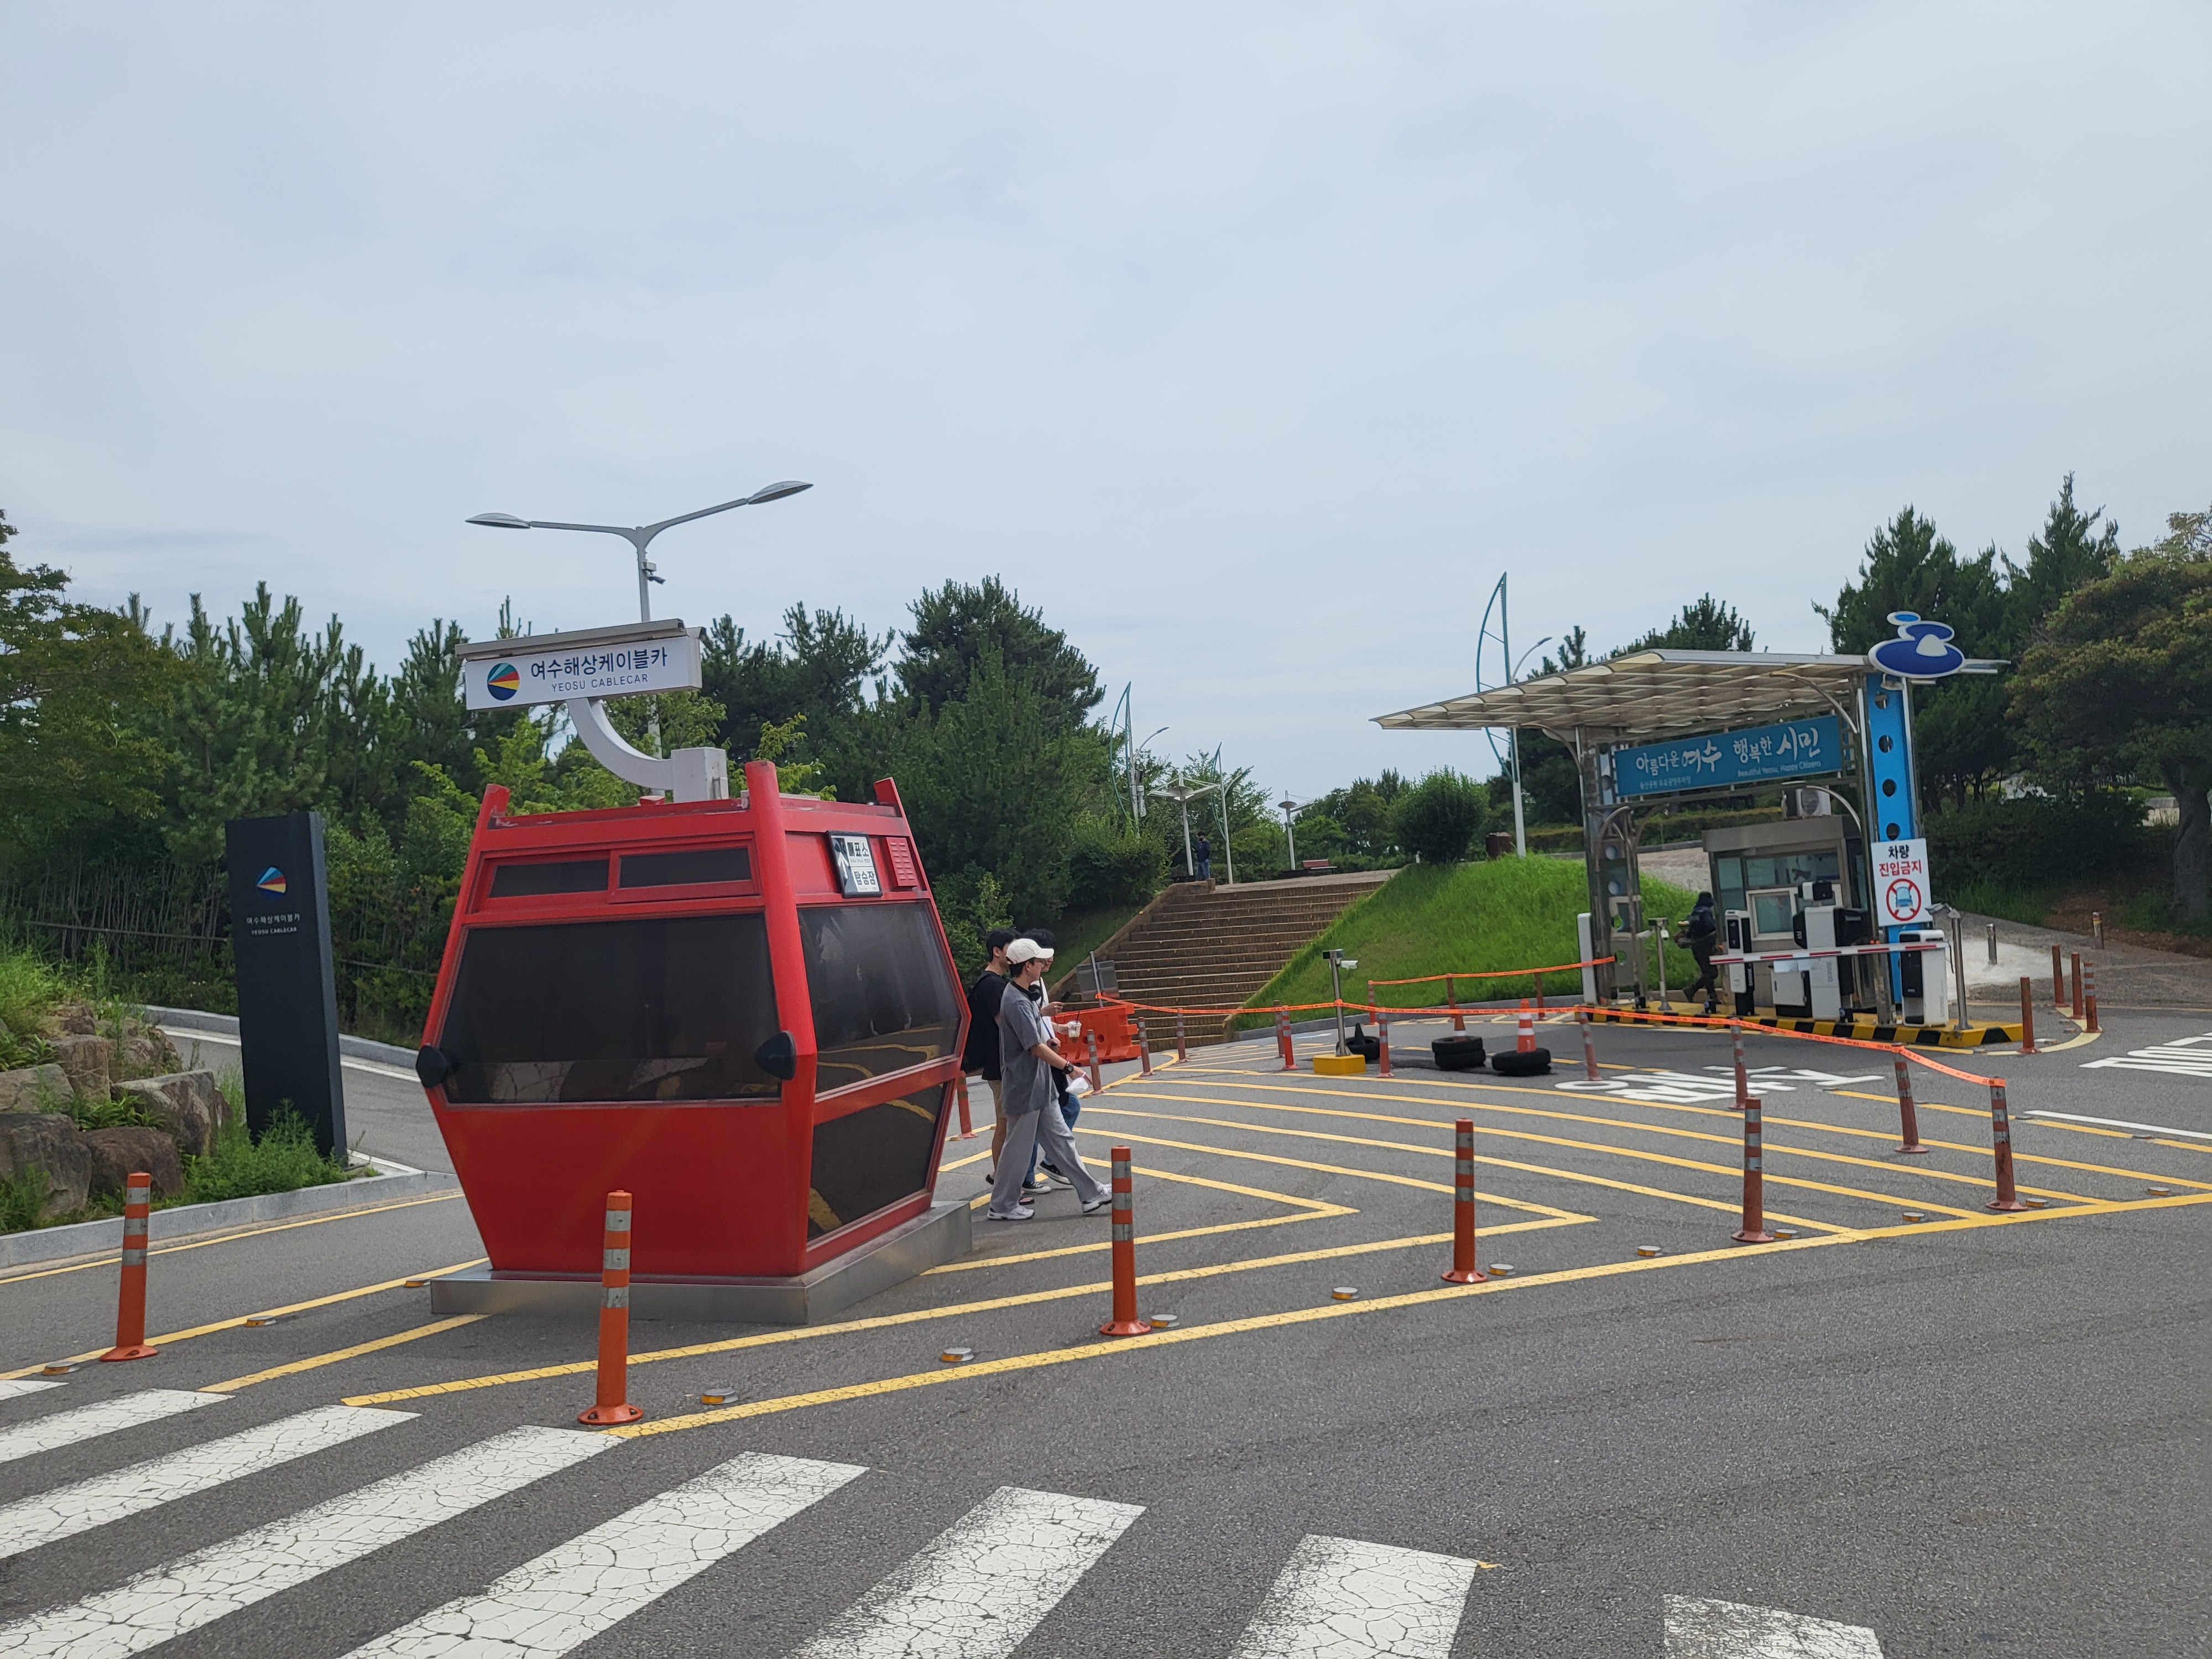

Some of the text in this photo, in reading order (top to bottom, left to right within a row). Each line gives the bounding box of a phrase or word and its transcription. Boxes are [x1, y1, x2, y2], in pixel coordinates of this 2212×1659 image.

[531, 646, 668, 681] 여수해상케이블카
[552, 674, 649, 692] YEOSU CABLECAR
[1636, 726, 1821, 776] 아름다운 여수 행복한 시민
[847, 842, 869, 857] 매표소
[1888, 844, 1910, 859] 차량
[1879, 859, 1922, 877] 진입금지
[853, 870, 876, 885] 탑승장
[246, 914, 300, 925] 여수해상케이블카
